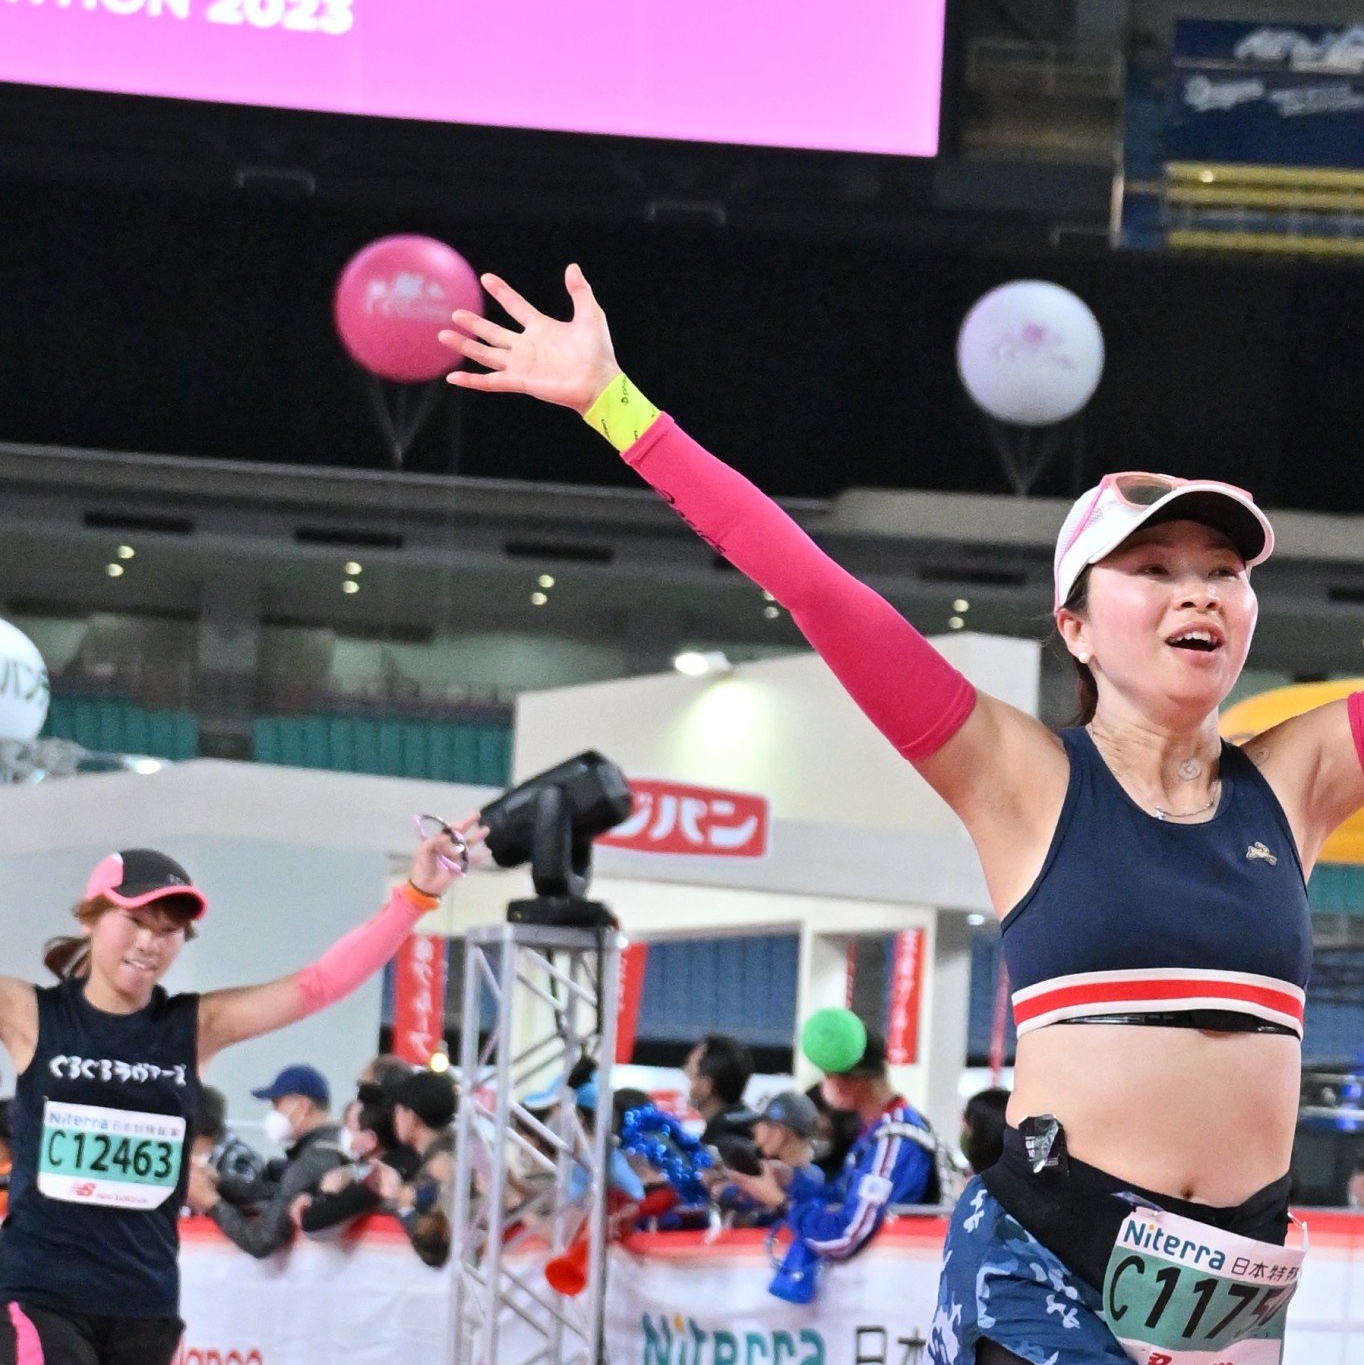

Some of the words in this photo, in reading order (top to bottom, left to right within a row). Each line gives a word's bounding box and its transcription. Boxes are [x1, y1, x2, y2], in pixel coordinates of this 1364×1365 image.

[50, 1111, 110, 1131] Niterra
[47, 1129, 173, 1179] C12463
[1122, 1219, 1227, 1271] Niterra
